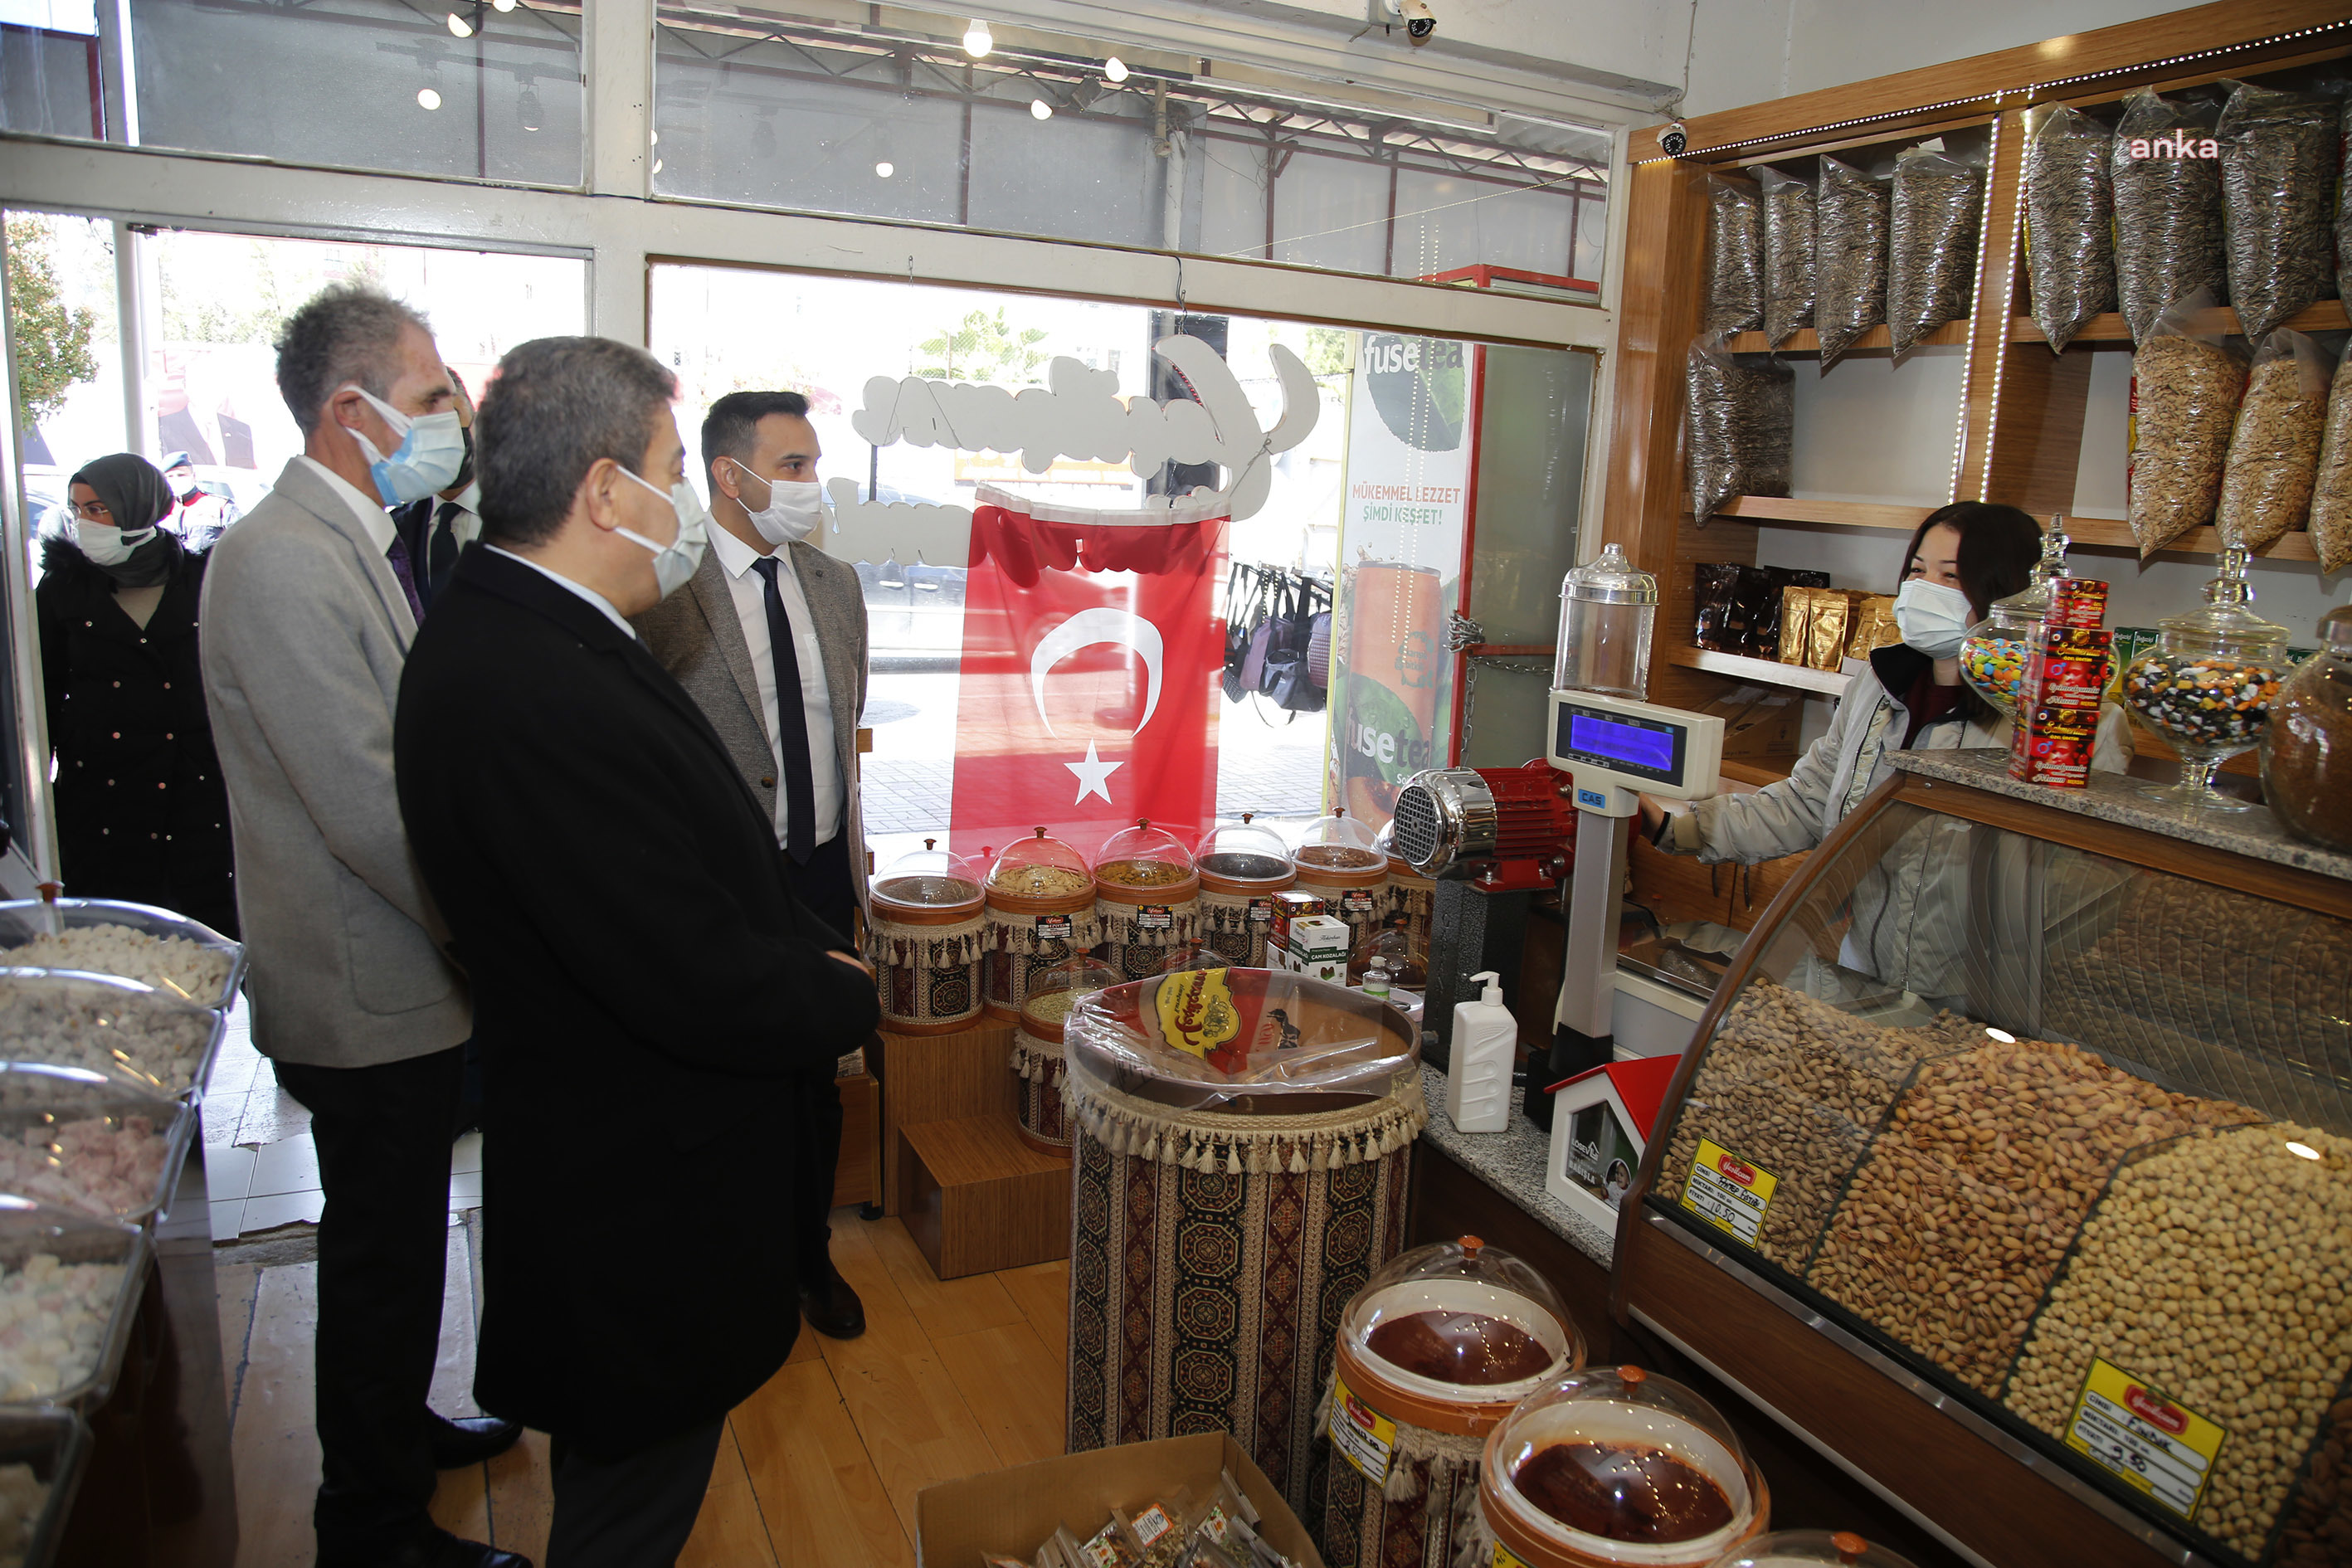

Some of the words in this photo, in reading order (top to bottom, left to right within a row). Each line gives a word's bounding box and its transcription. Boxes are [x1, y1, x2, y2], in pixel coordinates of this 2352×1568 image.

[1365, 335, 1464, 374] fusetea
[1352, 481, 1413, 502] MÜKEMMEL
[1415, 486, 1461, 504] LEZZET
[1363, 502, 1393, 522] ŞİMDİ
[1395, 507, 1443, 525] KEŞFET!
[1581, 791, 1602, 806] CAS
[1711, 1202, 1736, 1223] 10.50
